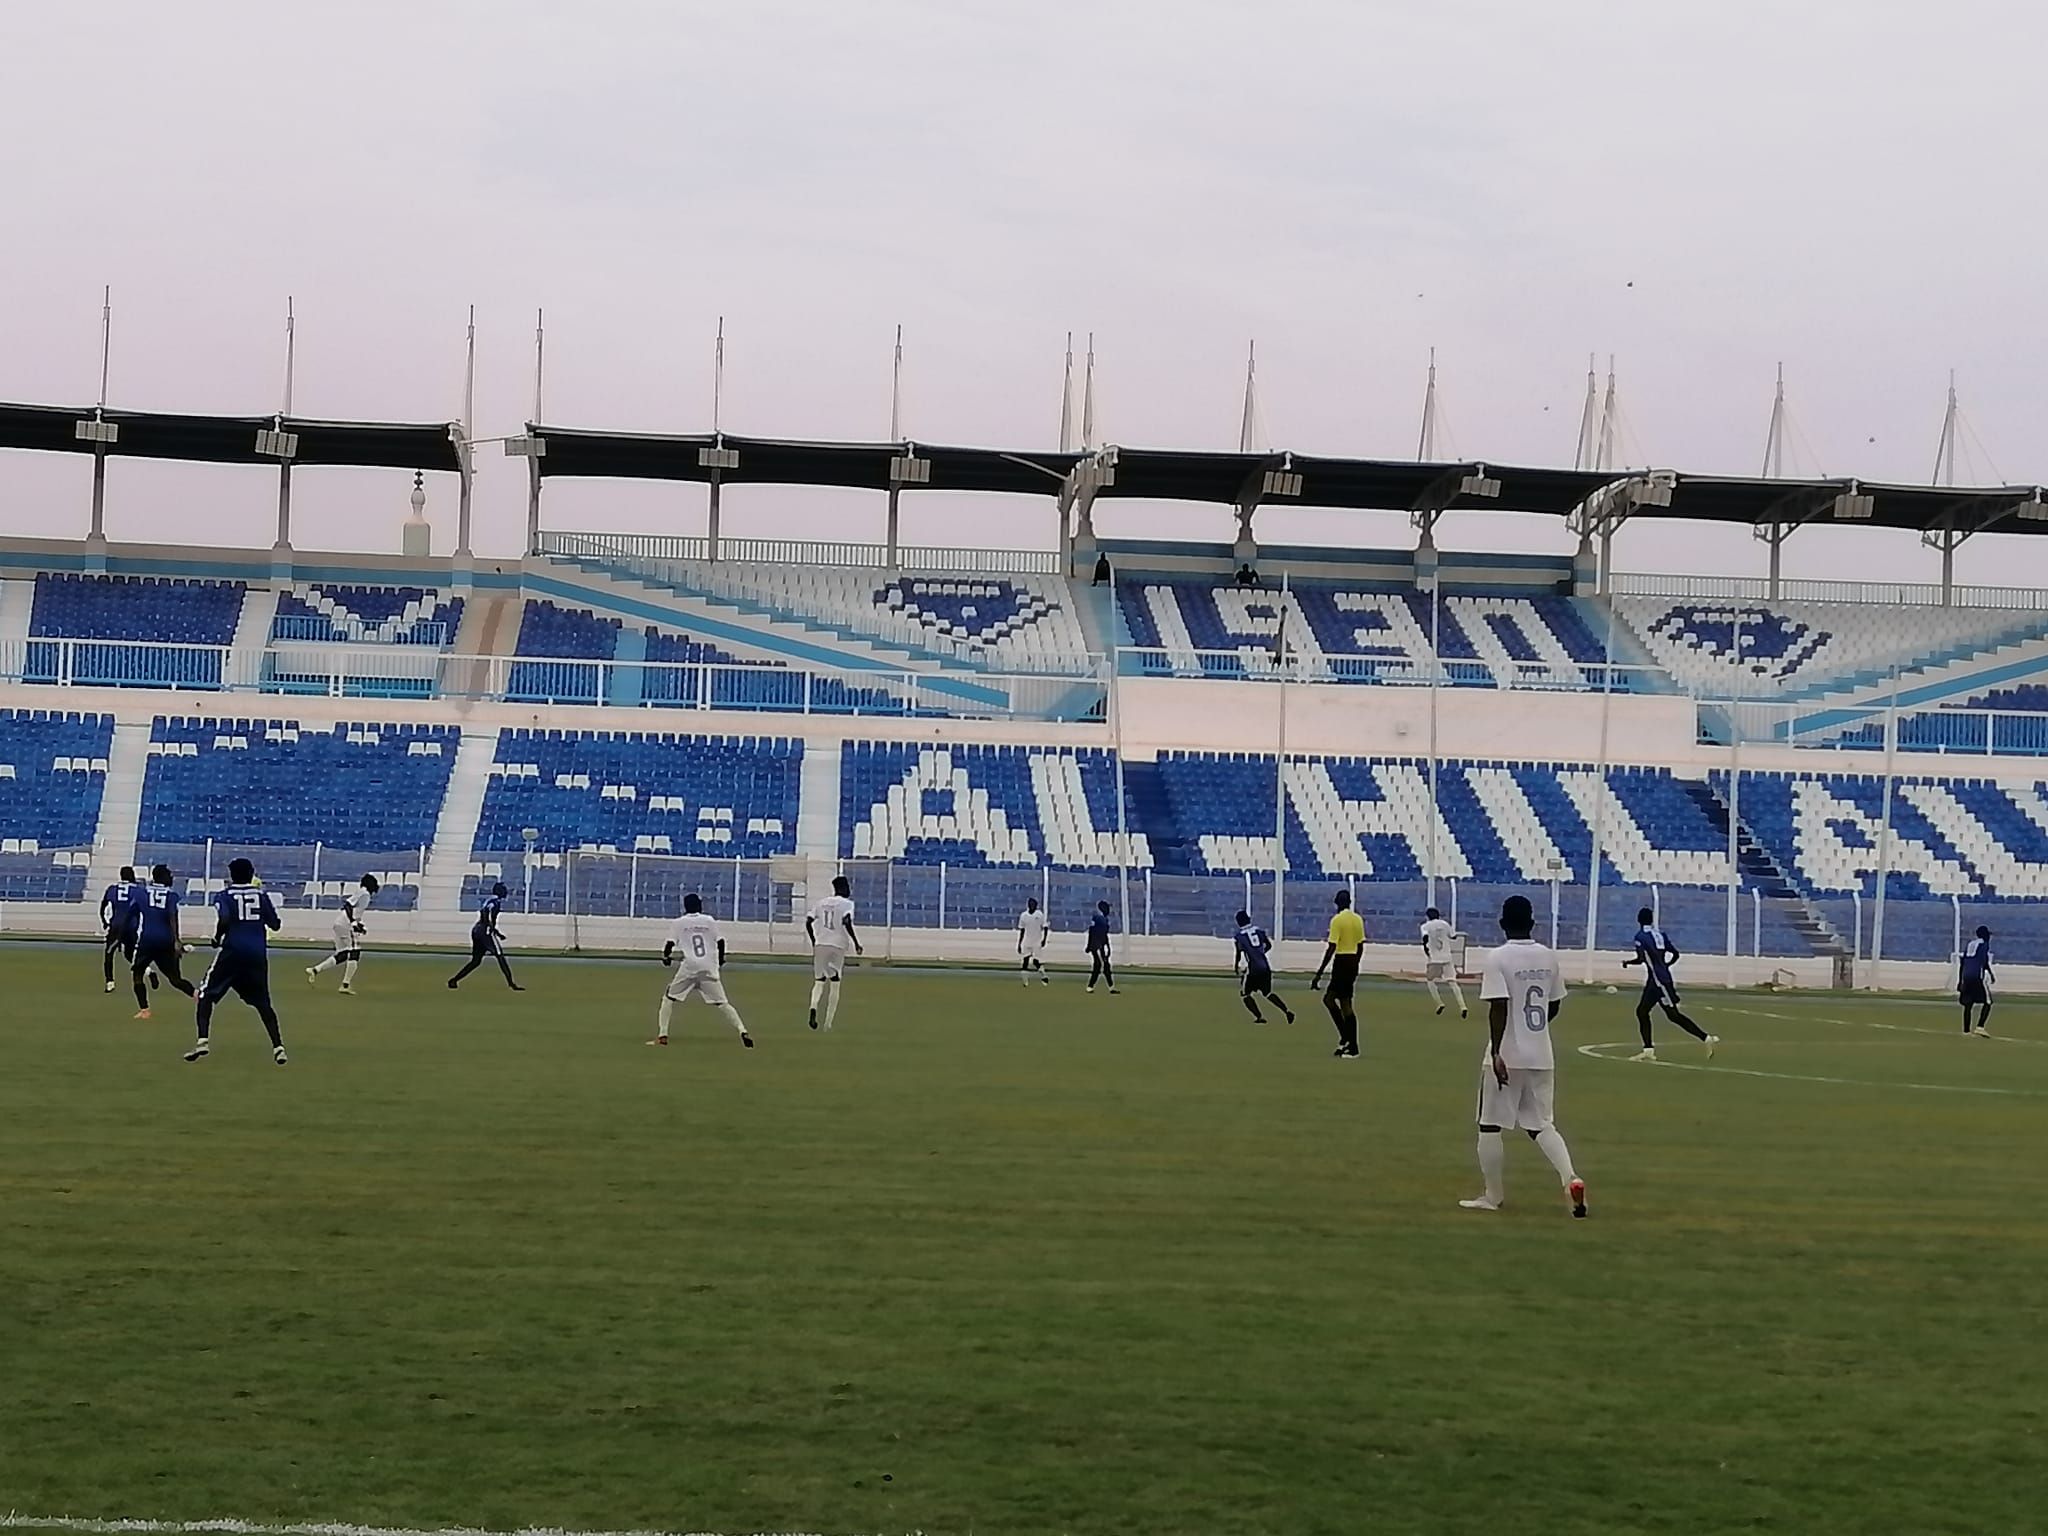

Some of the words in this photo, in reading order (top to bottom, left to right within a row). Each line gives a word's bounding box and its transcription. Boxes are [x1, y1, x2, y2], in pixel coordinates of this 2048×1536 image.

[1143, 584, 1591, 686] 1930
[117, 883, 129, 901] 2
[147, 887, 168, 909] 15
[233, 894, 261, 921] 12
[692, 934, 706, 958] 8
[1523, 985, 1546, 1032] 6
